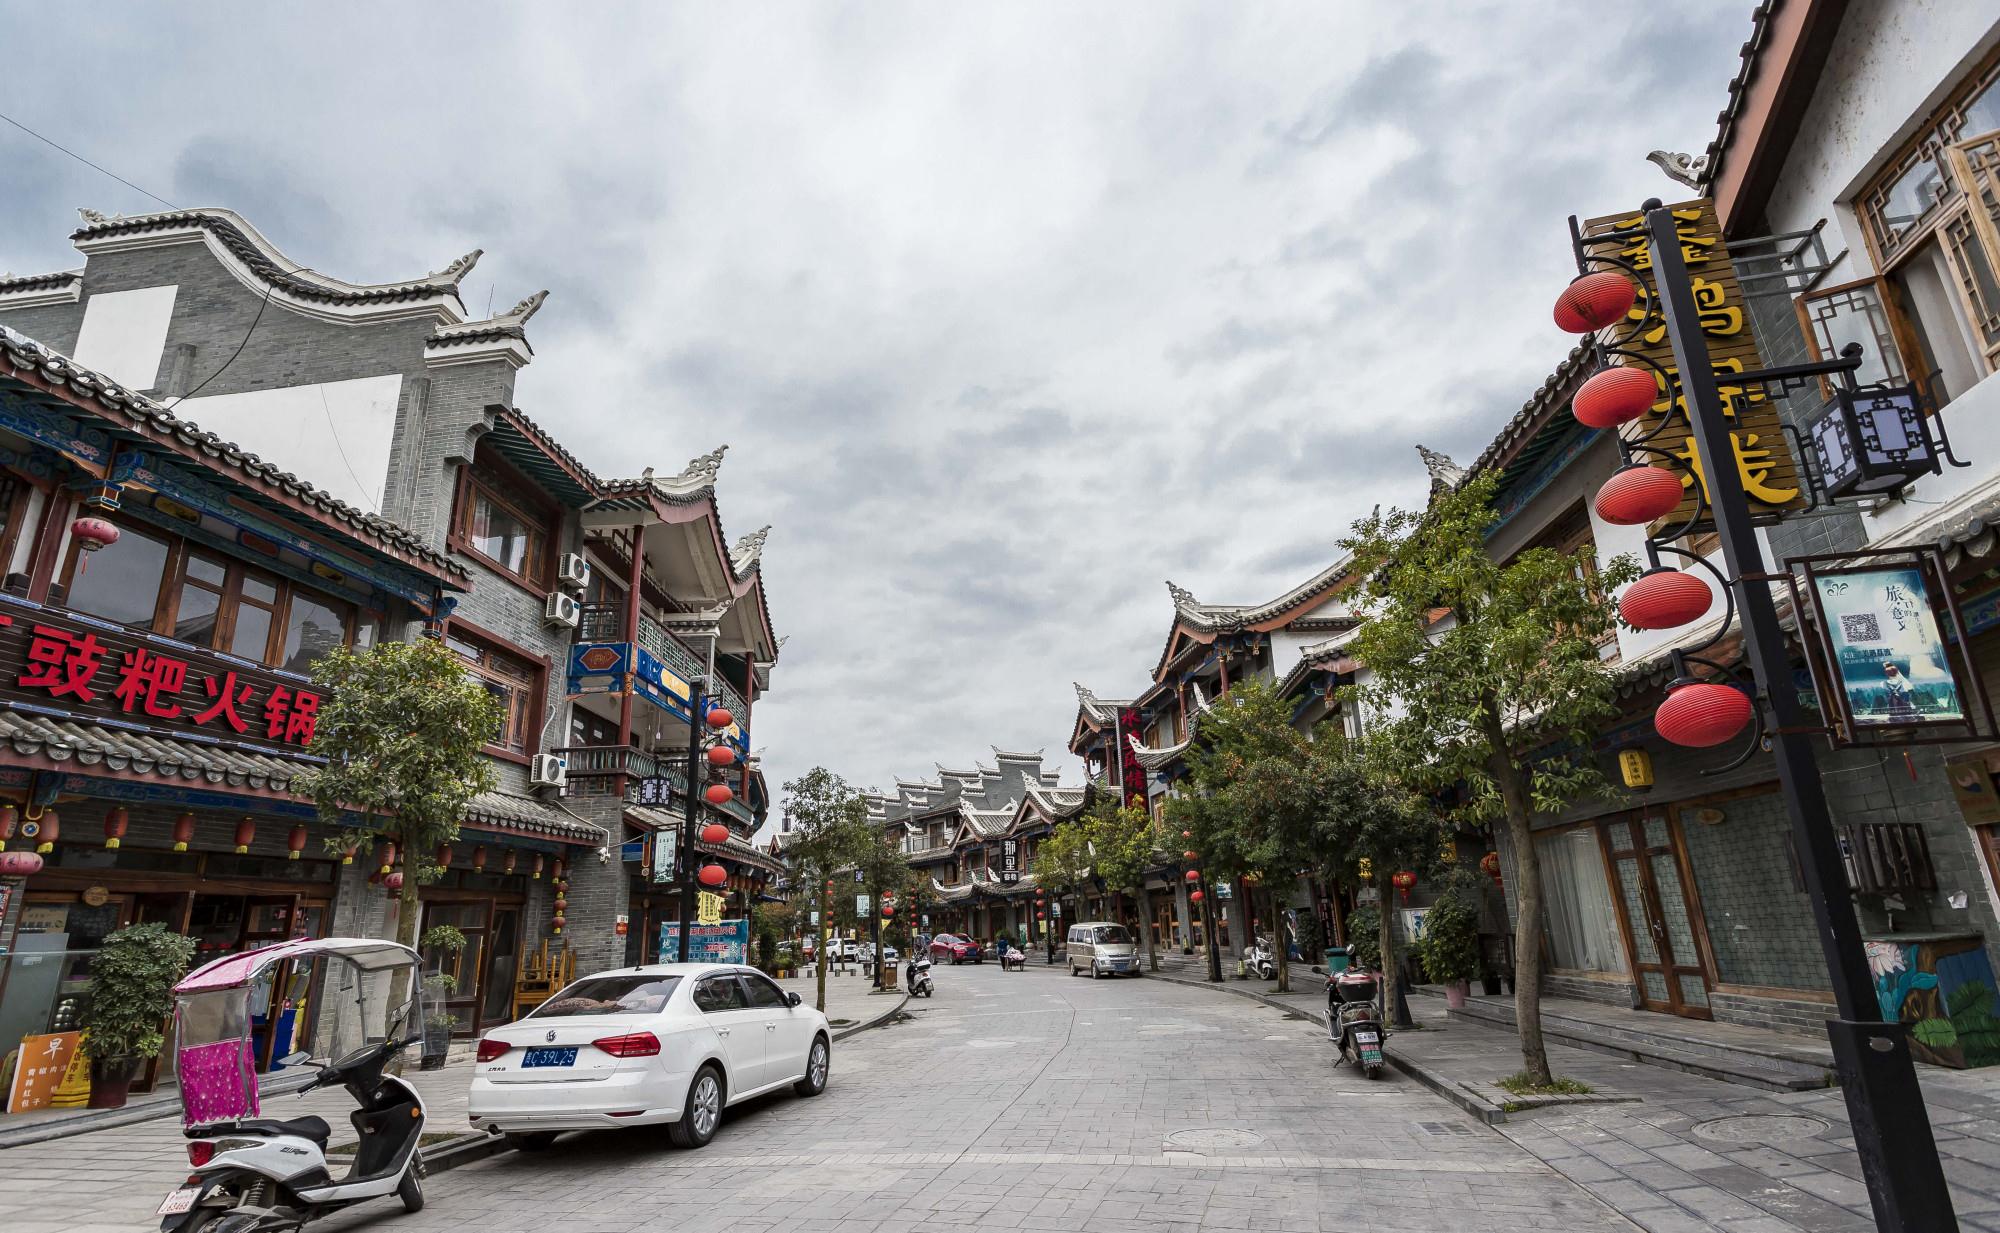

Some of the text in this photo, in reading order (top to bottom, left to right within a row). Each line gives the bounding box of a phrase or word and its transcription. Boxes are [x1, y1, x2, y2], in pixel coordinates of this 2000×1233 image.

[0, 615, 319, 745] 豉粑火锅
[1004, 840, 1016, 871] 那里
